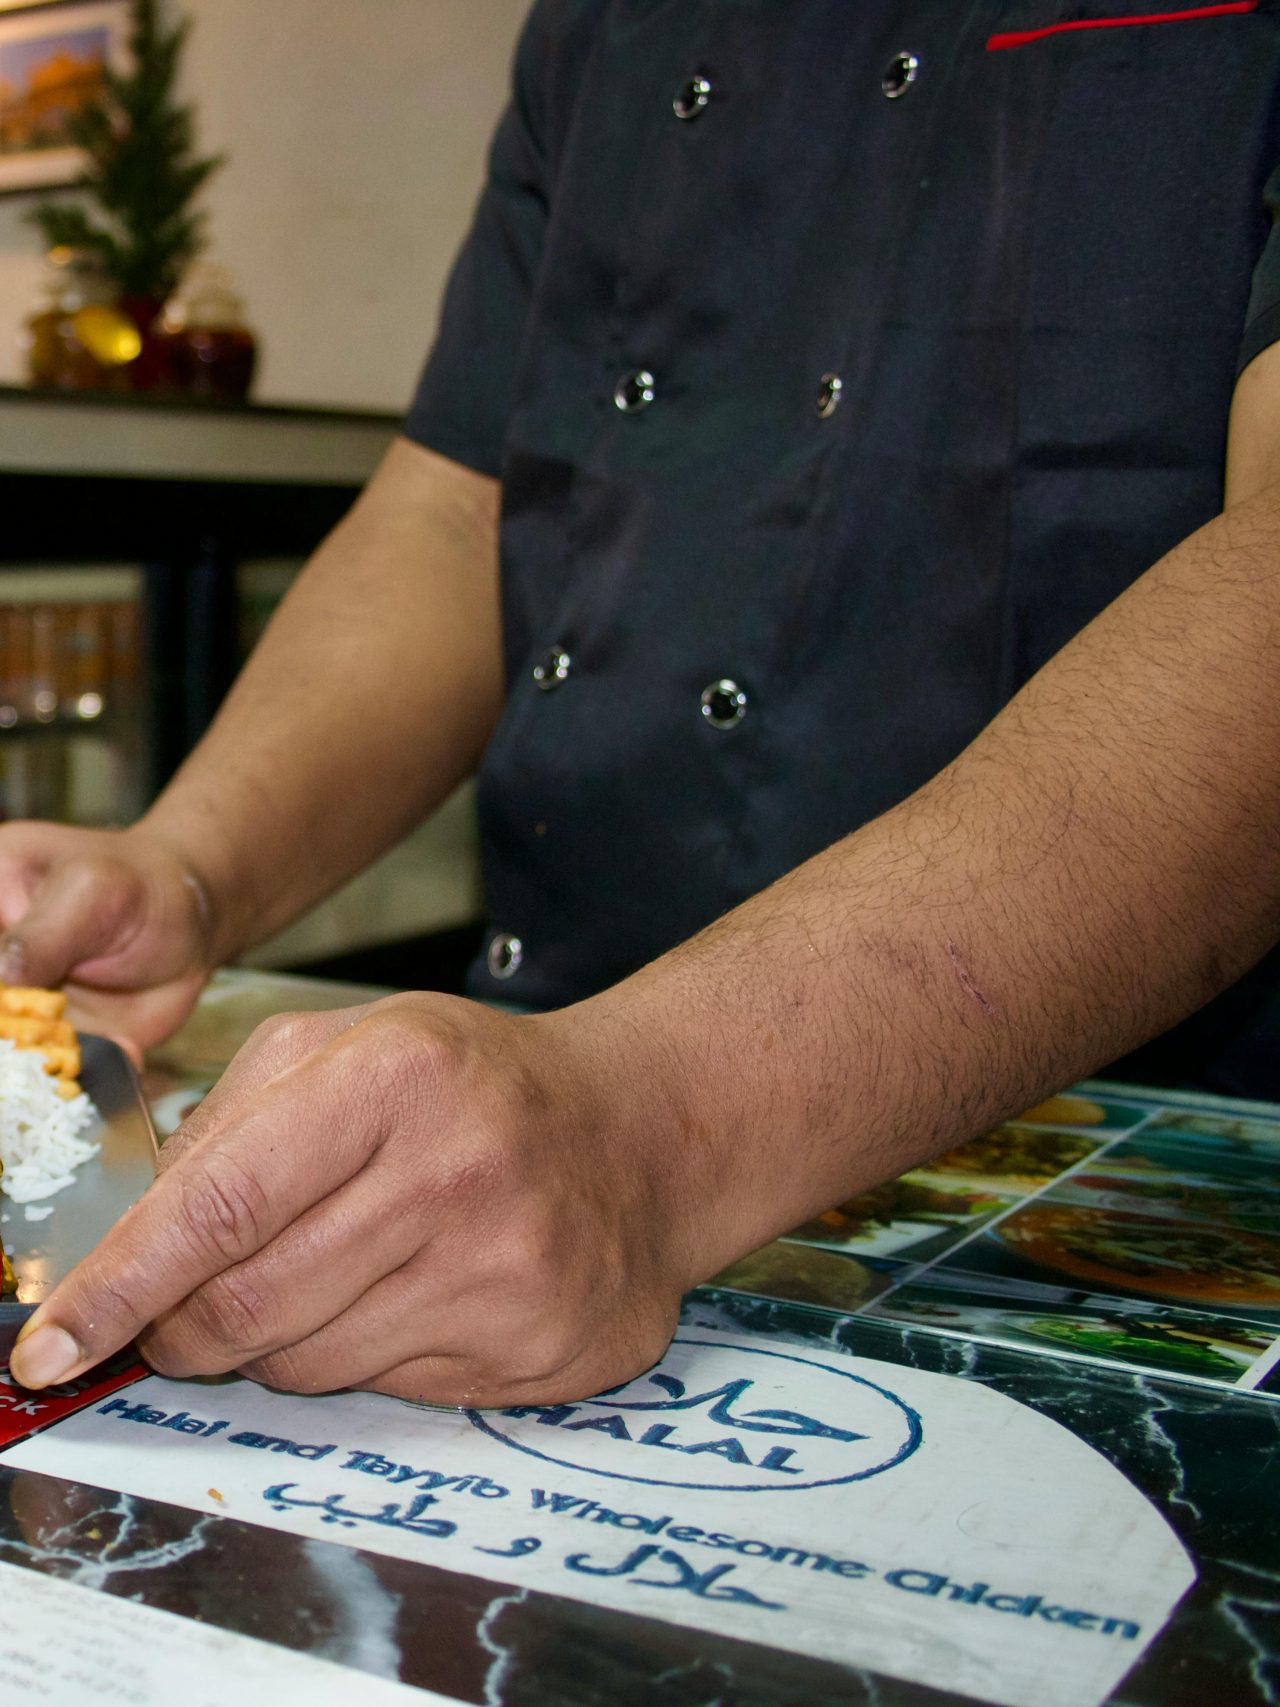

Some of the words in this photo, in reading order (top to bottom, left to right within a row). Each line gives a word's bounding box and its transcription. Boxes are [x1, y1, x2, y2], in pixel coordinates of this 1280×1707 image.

[500, 1404, 804, 1475] HALAL
[95, 1398, 232, 1437] Halal
[227, 1431, 339, 1461] and
[338, 1450, 511, 1500] Tayyib
[531, 1488, 876, 1579] Wholesome
[883, 1568, 1142, 1640] Chicken
[262, 1482, 459, 1539] طيب
[473, 1536, 542, 1558] و
[563, 1543, 789, 1611] حلال
